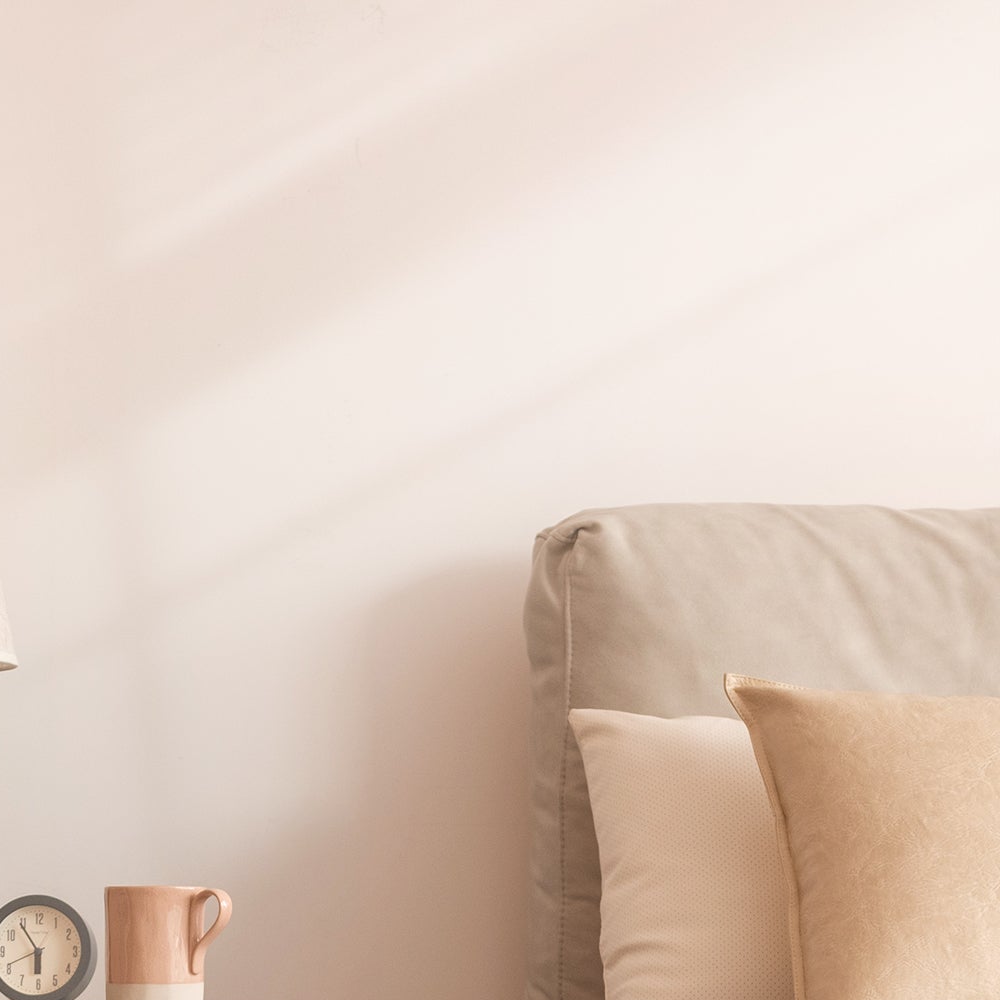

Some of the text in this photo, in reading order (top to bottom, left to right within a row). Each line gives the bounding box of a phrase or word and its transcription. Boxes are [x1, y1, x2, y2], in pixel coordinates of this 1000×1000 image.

[19, 917, 26, 929] 11
[35, 913, 44, 925] 12
[7, 929, 15, 941] 10
[66, 928, 72, 940] 2
[0, 946, 5, 958] 9
[73, 946, 78, 958] 3
[6, 964, 12, 975] 8
[65, 963, 71, 975] 4
[20, 974, 24, 986] 7
[36, 979, 41, 990] 6
[53, 975, 58, 986] 5
